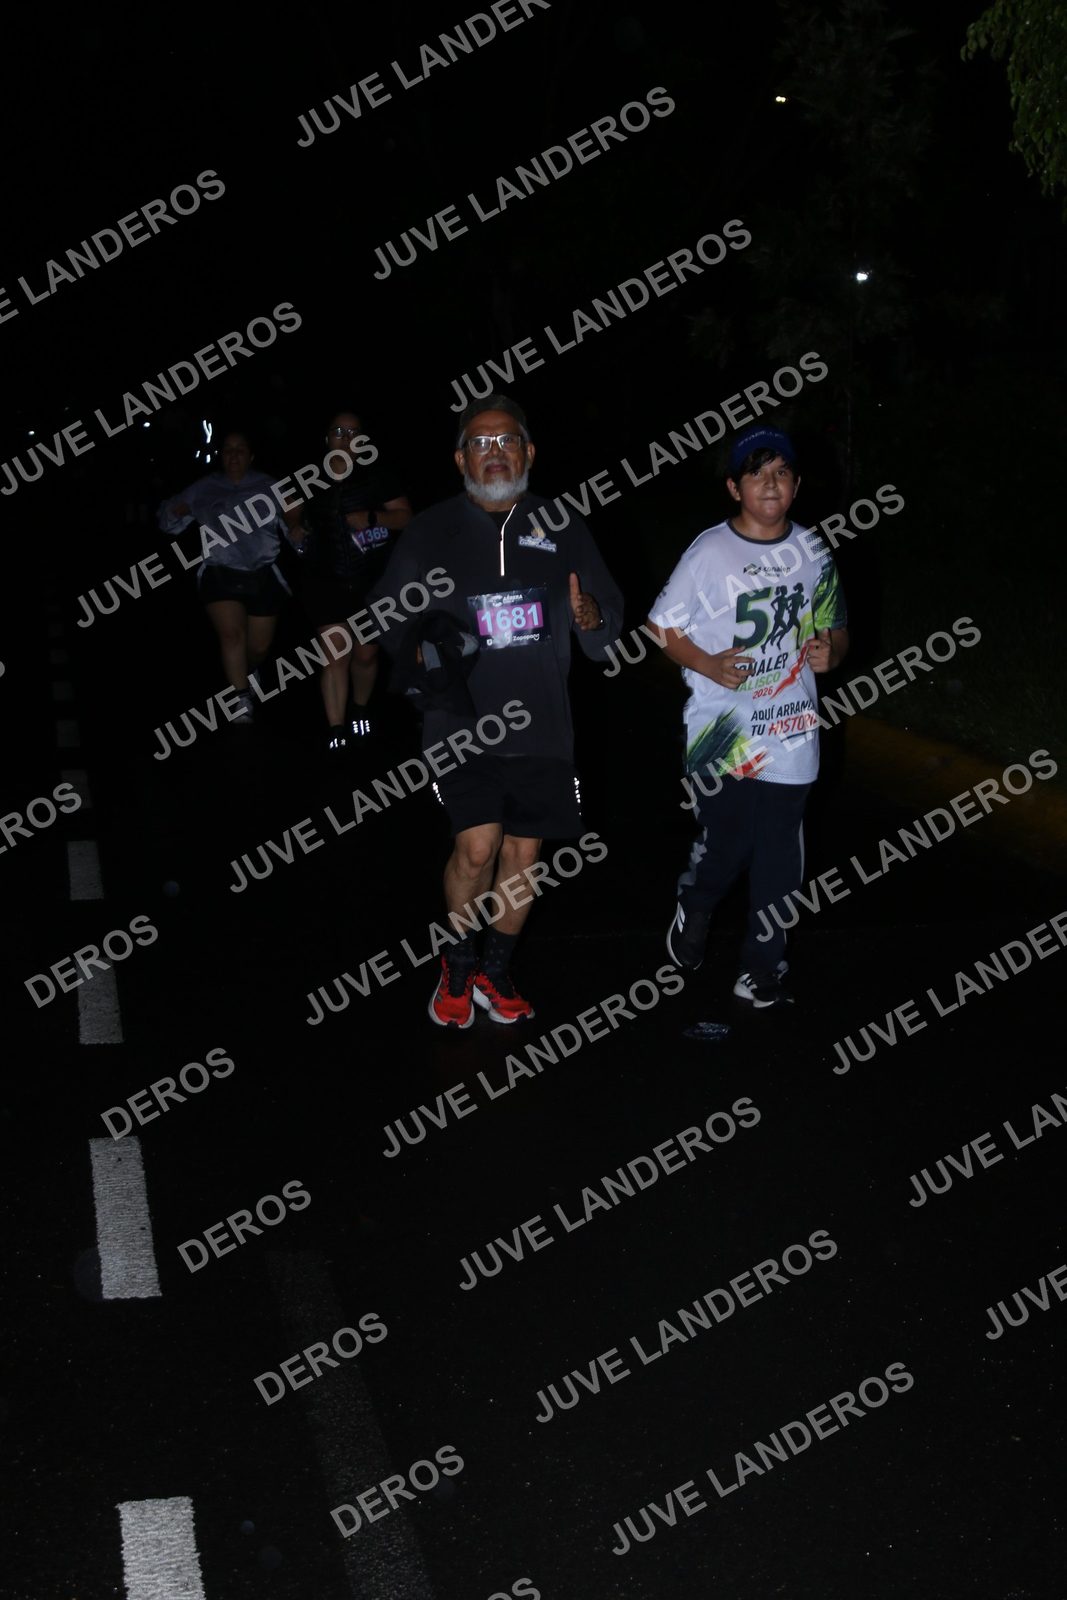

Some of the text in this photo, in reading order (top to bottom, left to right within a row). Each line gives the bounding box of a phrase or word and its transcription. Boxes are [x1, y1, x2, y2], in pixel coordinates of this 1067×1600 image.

[358, 526, 389, 544] 1369
[481, 603, 539, 633] 1681
[735, 652, 789, 678] NALEP
[736, 671, 782, 692] ALISCO
[752, 686, 774, 700] 2026
[750, 704, 775, 722] AQUÍ
[751, 724, 766, 737] TU
